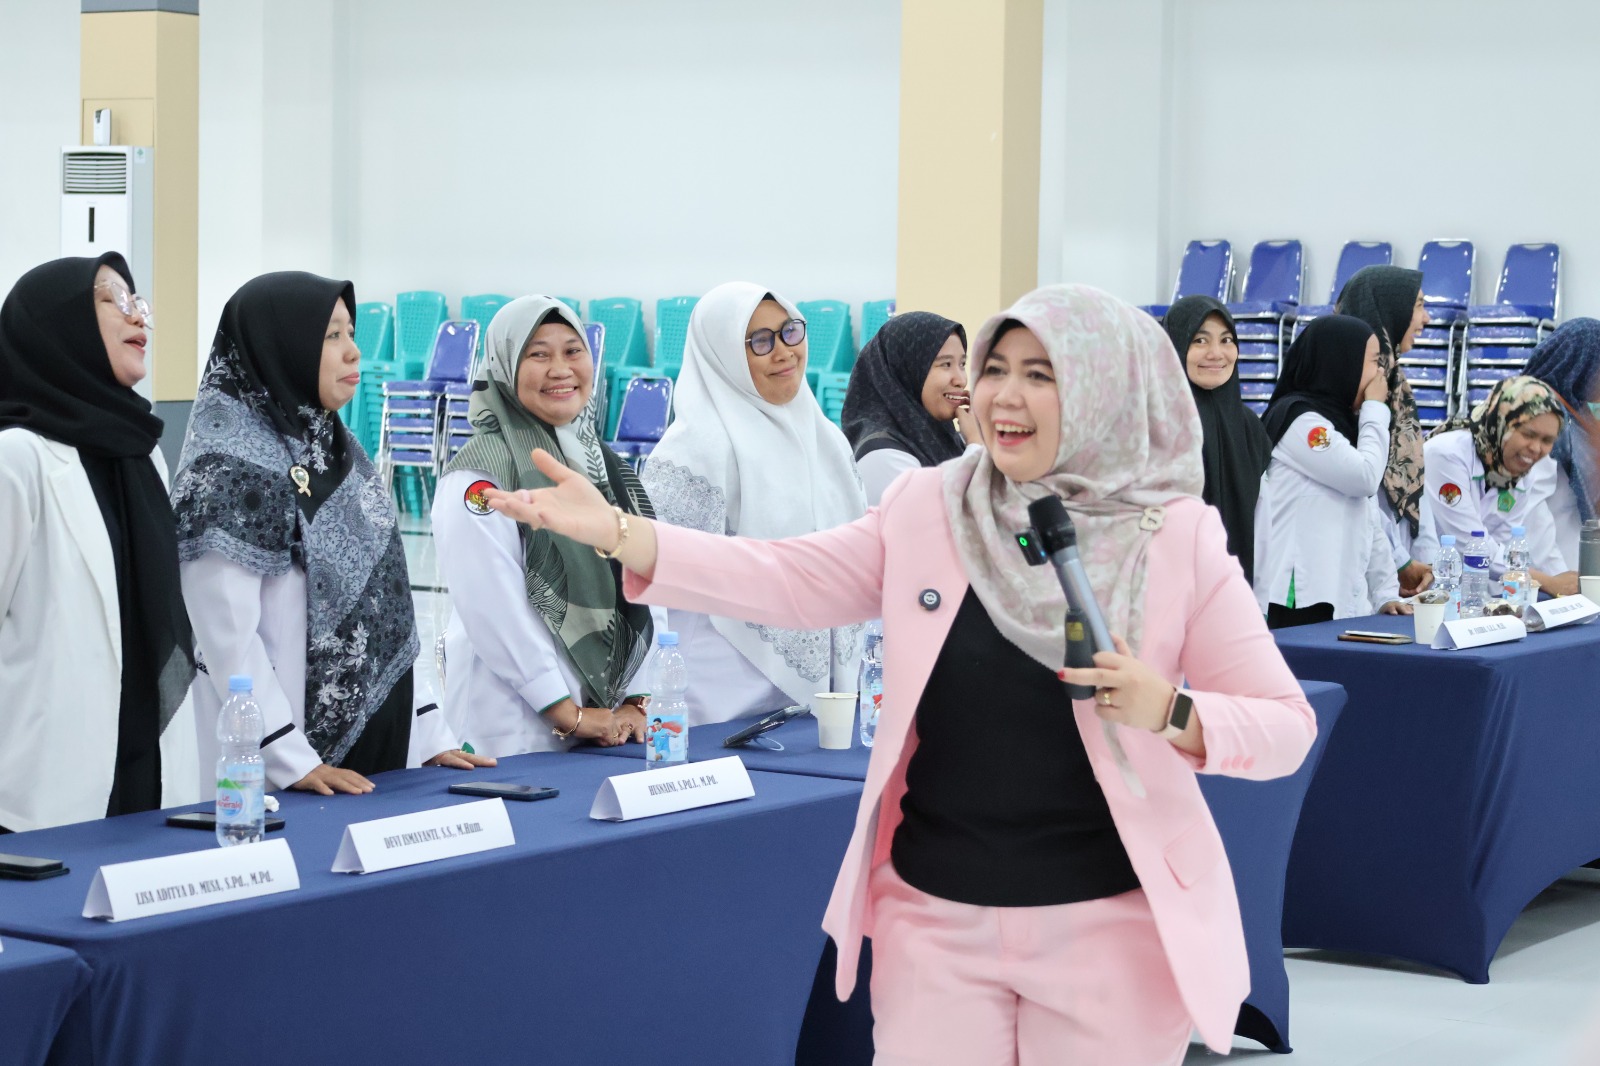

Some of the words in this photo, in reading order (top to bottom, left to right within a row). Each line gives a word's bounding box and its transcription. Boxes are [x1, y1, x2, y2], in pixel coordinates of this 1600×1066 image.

[699, 774, 719, 787] M.Pd.
[384, 834, 402, 849] DEVI
[401, 828, 441, 846] ISMAYANTI,
[456, 822, 484, 836] M.Hum.
[135, 890, 155, 906] LISA
[156, 885, 188, 902] ADITYA
[188, 883, 199, 897] D.
[199, 879, 224, 894] MUSA,
[224, 875, 250, 890] S.Pd.,
[250, 870, 274, 885] M.Pd.
